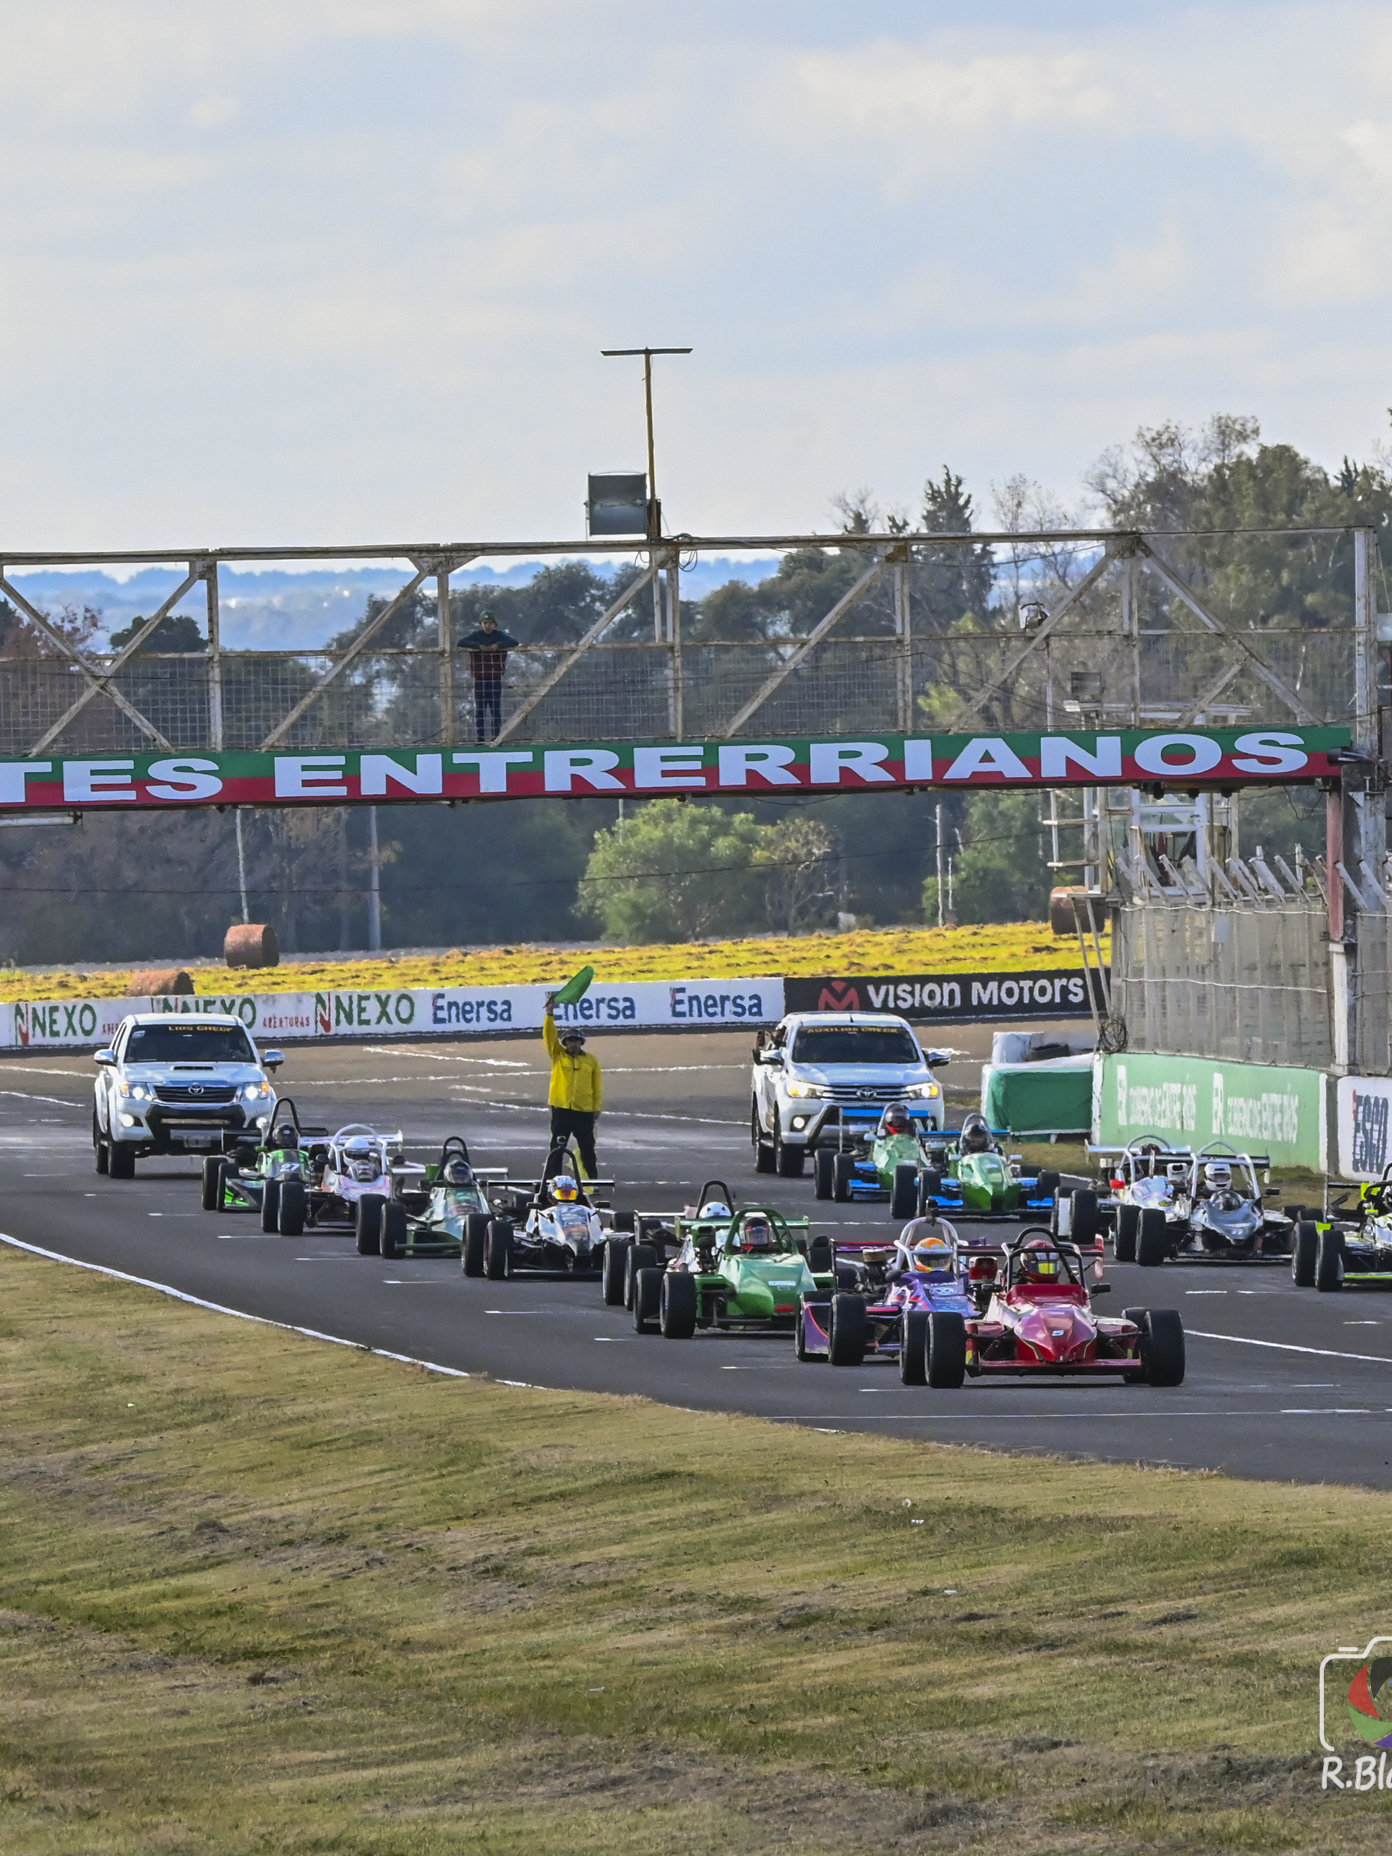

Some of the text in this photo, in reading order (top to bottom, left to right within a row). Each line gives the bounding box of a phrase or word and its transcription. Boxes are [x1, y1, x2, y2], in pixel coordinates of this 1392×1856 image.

[0, 731, 1309, 802] TES ENTRERRIANOS
[335, 993, 415, 1026] NEXO
[432, 992, 512, 1025] Enersa
[670, 987, 762, 1018] Enersa
[32, 1003, 97, 1038] NEXO
[280, 1163, 300, 1173] 27
